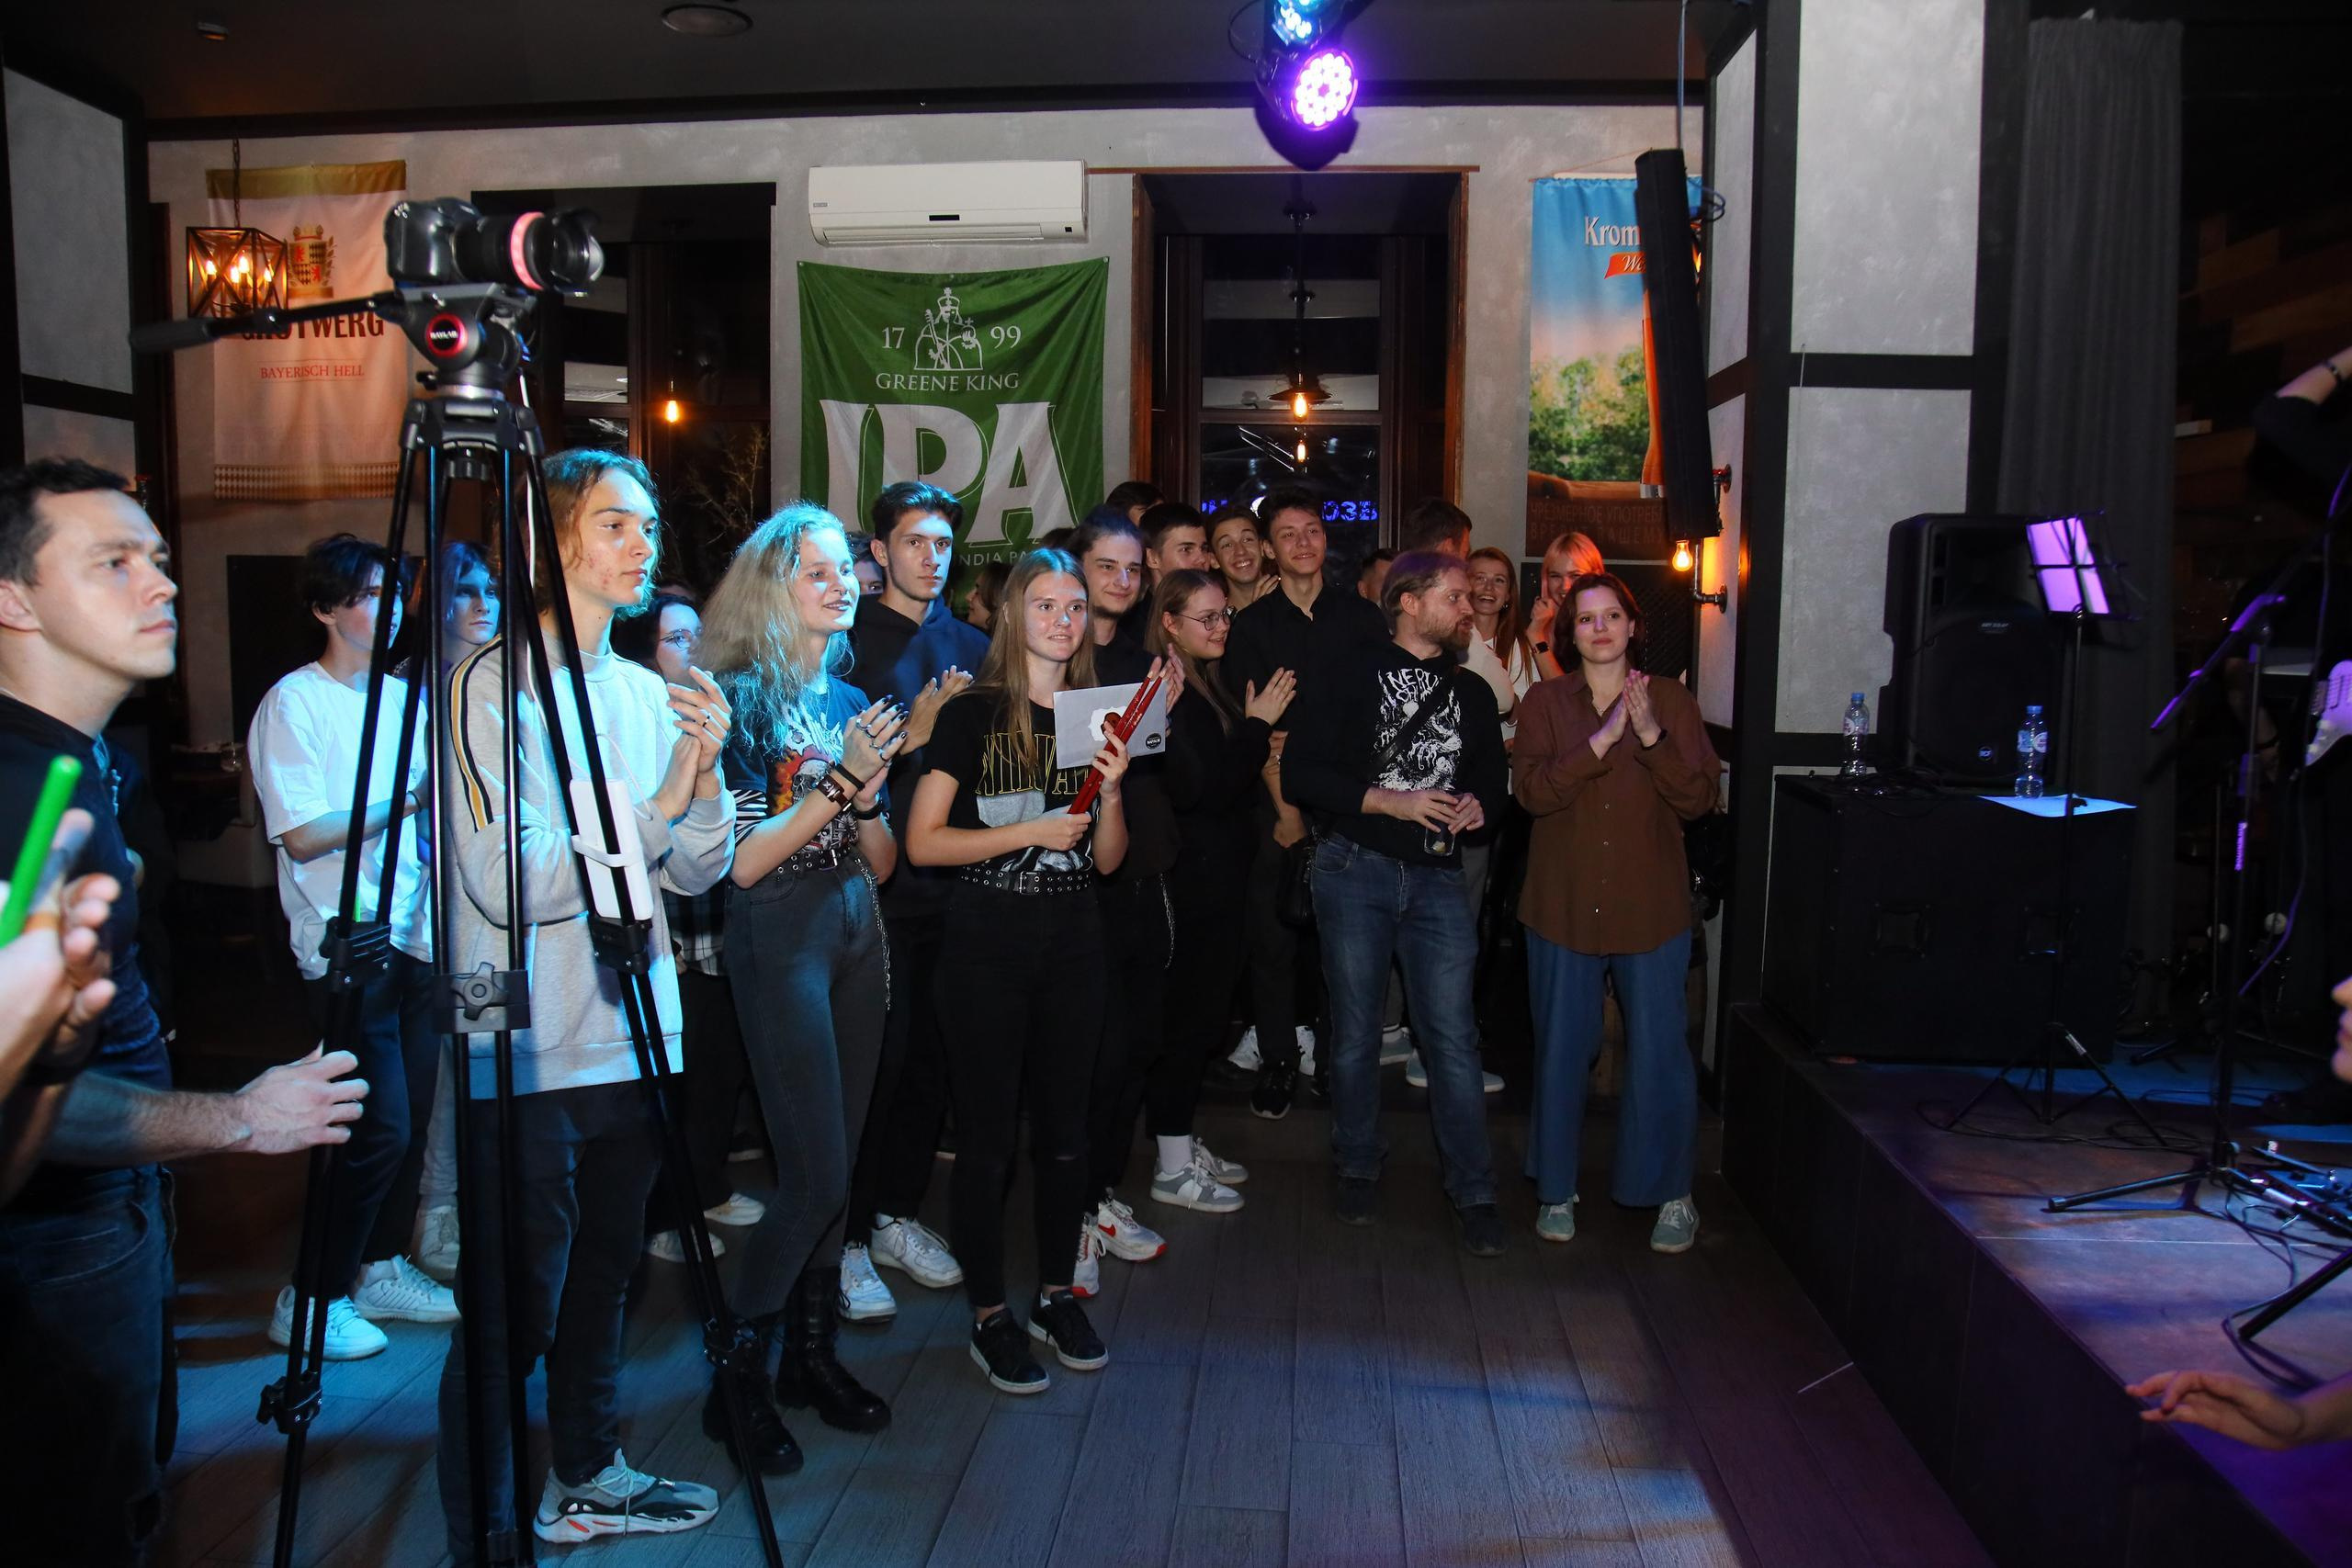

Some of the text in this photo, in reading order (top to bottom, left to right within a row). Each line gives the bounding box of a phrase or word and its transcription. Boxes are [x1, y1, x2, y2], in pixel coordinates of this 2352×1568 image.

[882, 325, 1022, 349] 17 99
[261, 365, 365, 379] BAYERISCH HELL
[876, 372, 1019, 391] GREENE KING
[820, 399, 1080, 547] IPA
